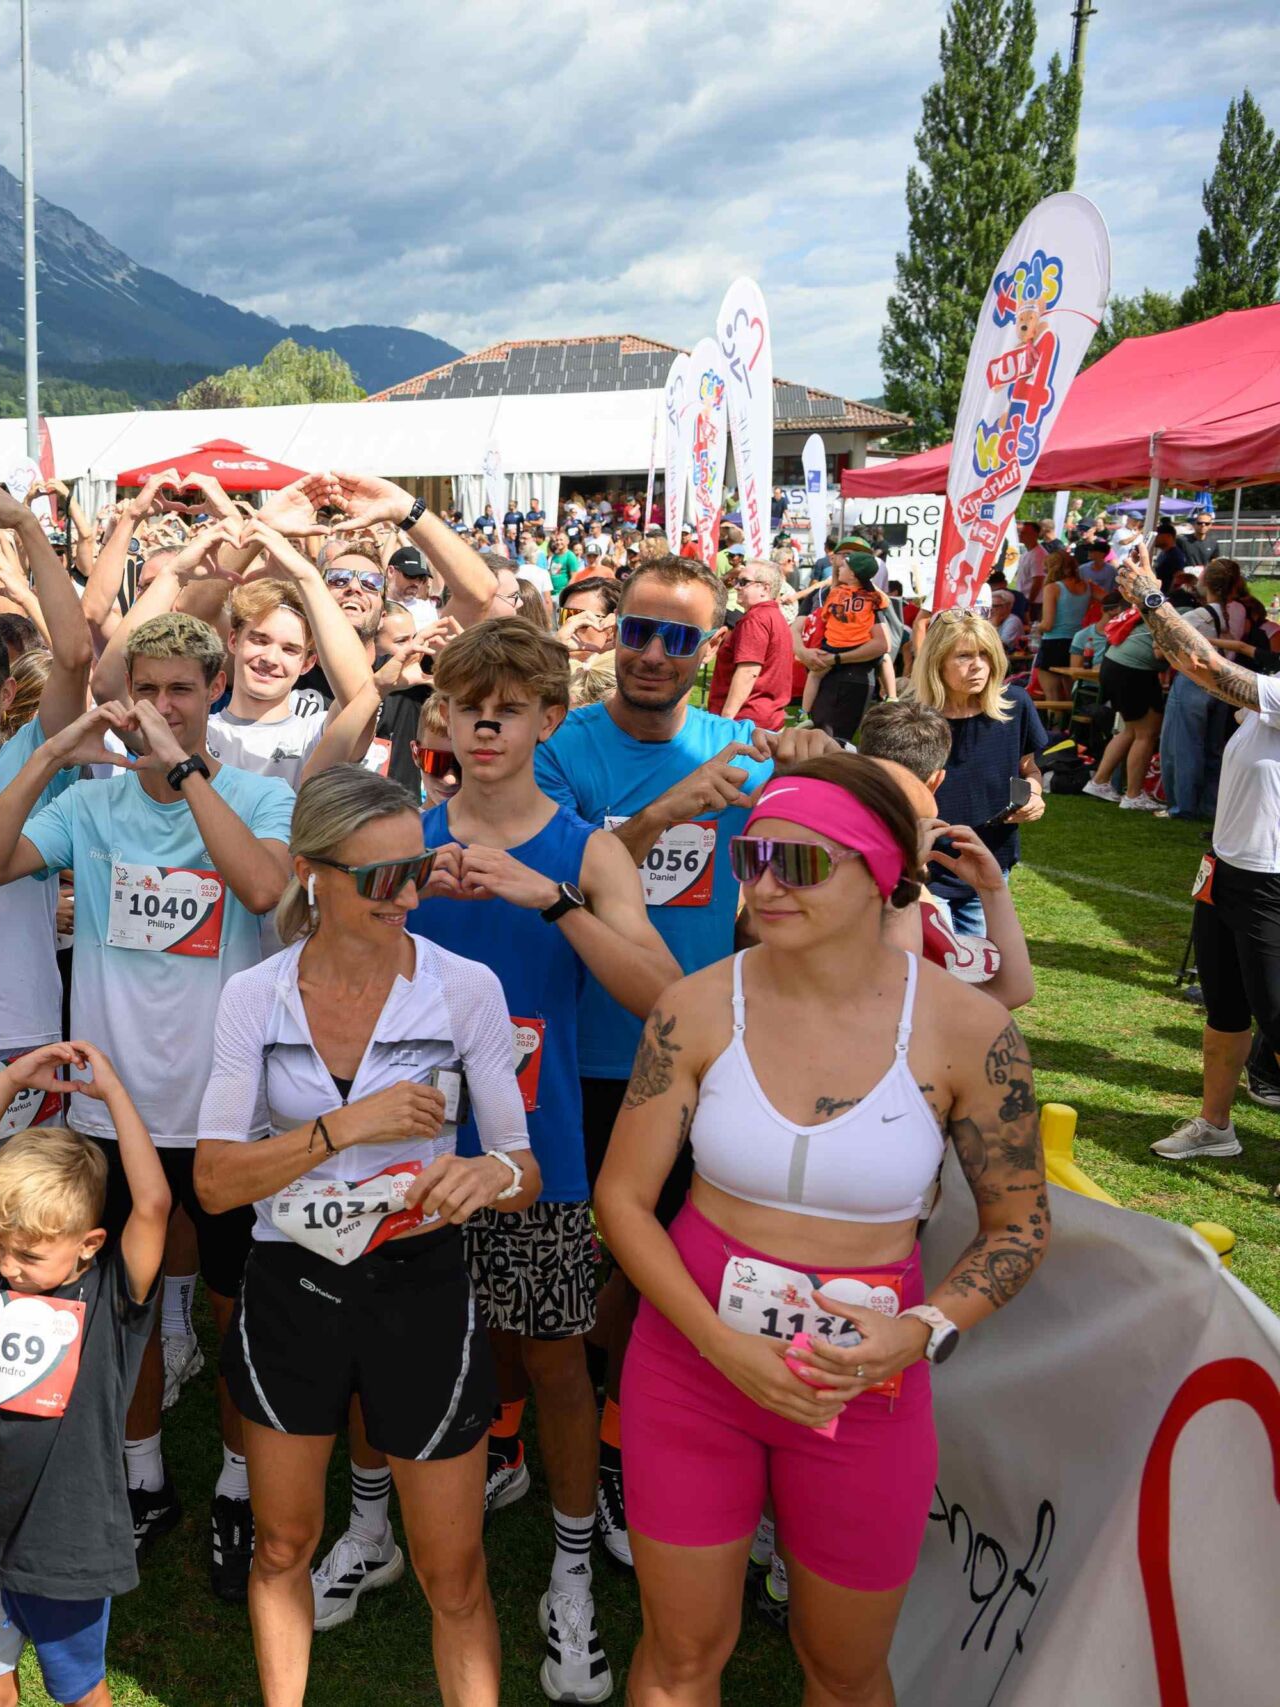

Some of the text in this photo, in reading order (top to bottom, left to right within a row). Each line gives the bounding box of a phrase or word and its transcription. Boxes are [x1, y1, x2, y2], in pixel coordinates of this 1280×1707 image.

[995, 255, 1061, 318] kids
[843, 597, 864, 613] 10
[637, 848, 700, 872] 056
[649, 872, 677, 882] Daniel
[129, 893, 198, 920] 1040
[147, 919, 176, 931] Philipp
[6, 1101, 33, 1115] Markus
[336, 1220, 362, 1238] Petra
